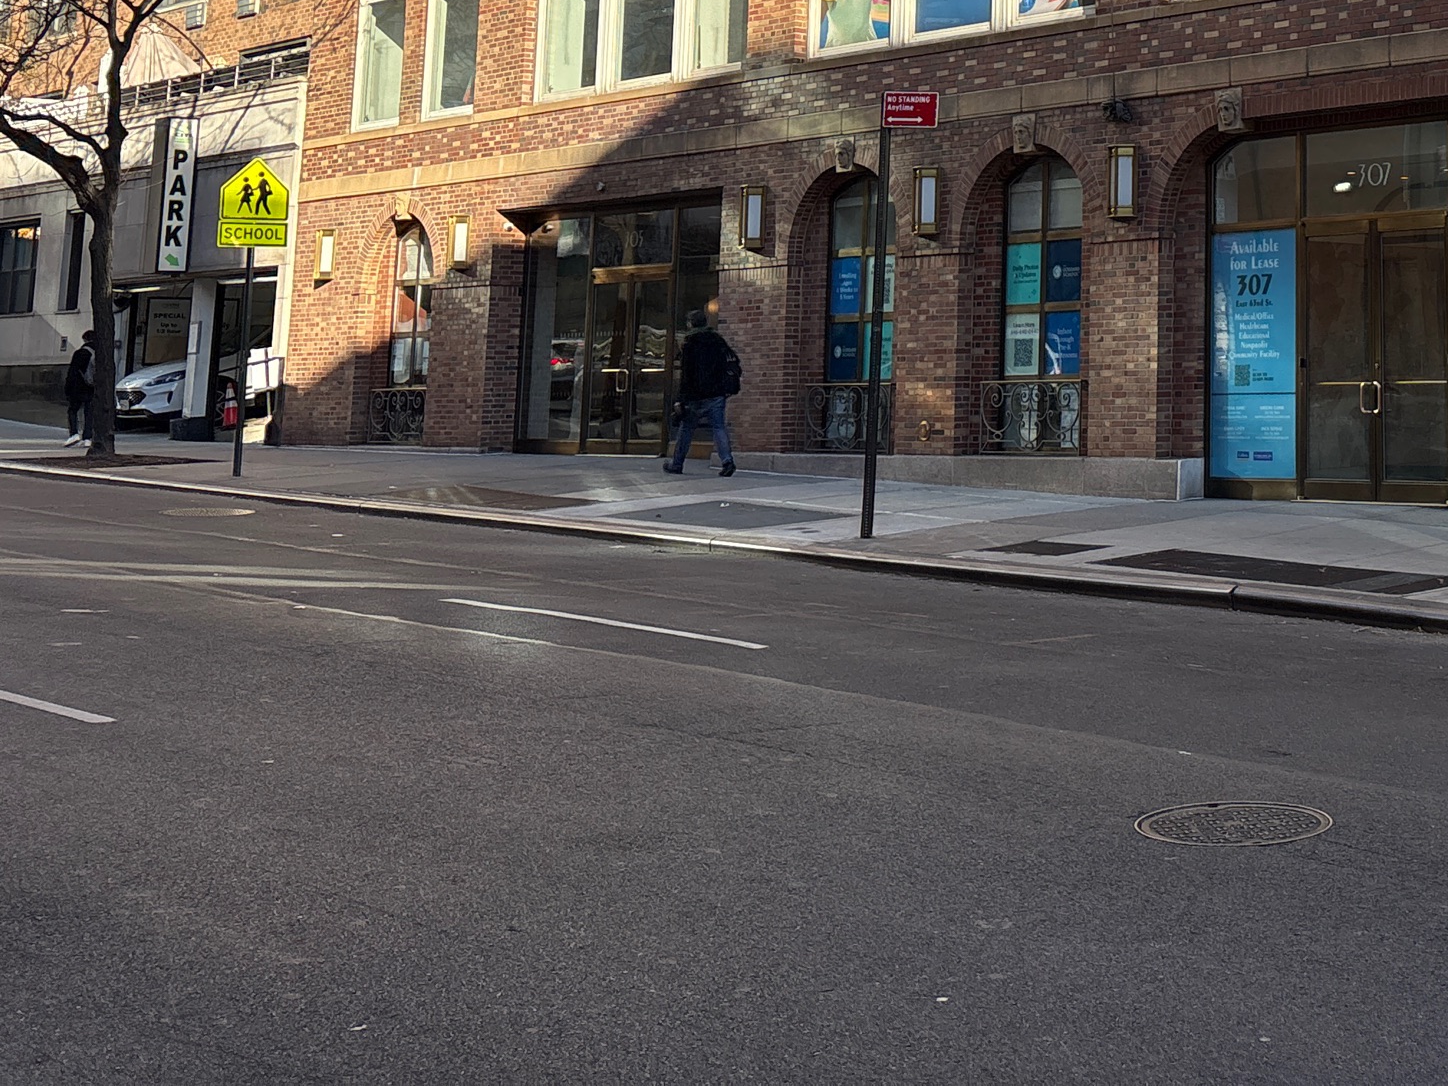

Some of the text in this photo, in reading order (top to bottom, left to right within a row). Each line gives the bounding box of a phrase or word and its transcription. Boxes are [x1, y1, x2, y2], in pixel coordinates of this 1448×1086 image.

[886, 104, 914, 112] Anytime
[887, 95, 931, 104] NO STANDING
[1358, 161, 1391, 188] 307
[164, 149, 188, 247] PARK
[223, 227, 283, 241] SCHOOL
[1236, 273, 1273, 296] 307
